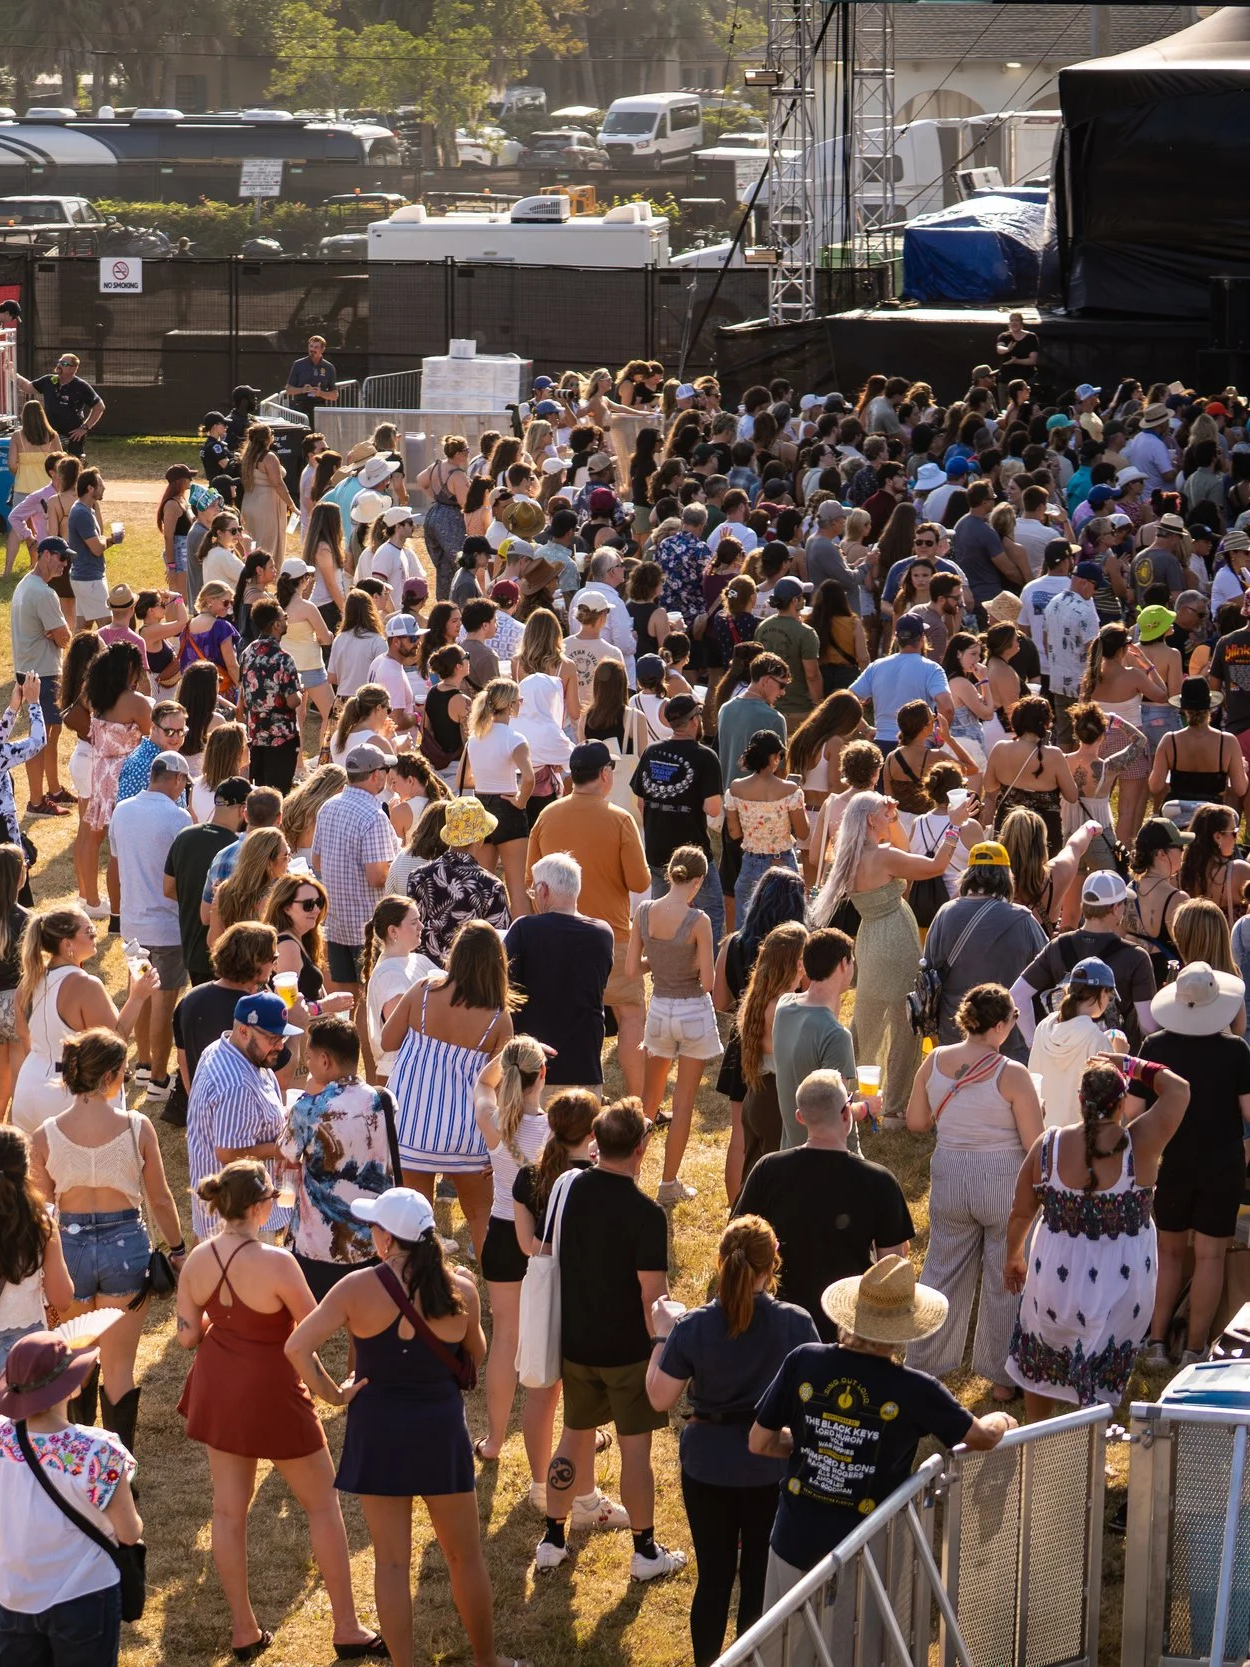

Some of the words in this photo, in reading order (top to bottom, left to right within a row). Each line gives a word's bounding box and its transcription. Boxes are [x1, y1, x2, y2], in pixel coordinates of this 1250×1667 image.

[824, 1379, 839, 1398] SING
[841, 1377, 857, 1386] OUT
[858, 1384, 870, 1406] LOUD
[805, 1415, 820, 1427] THE
[822, 1419, 851, 1435] BLACK
[853, 1428, 880, 1441] KEYS
[815, 1426, 835, 1437] LORD
[836, 1432, 864, 1446] HURON
[818, 1441, 832, 1449] WAR
[832, 1467, 864, 1479] ROGERS
[839, 1462, 846, 1470] &
[847, 1464, 876, 1474] SONS
[831, 1472, 846, 1483] KING
[821, 1482, 853, 1494] GOODMAN
